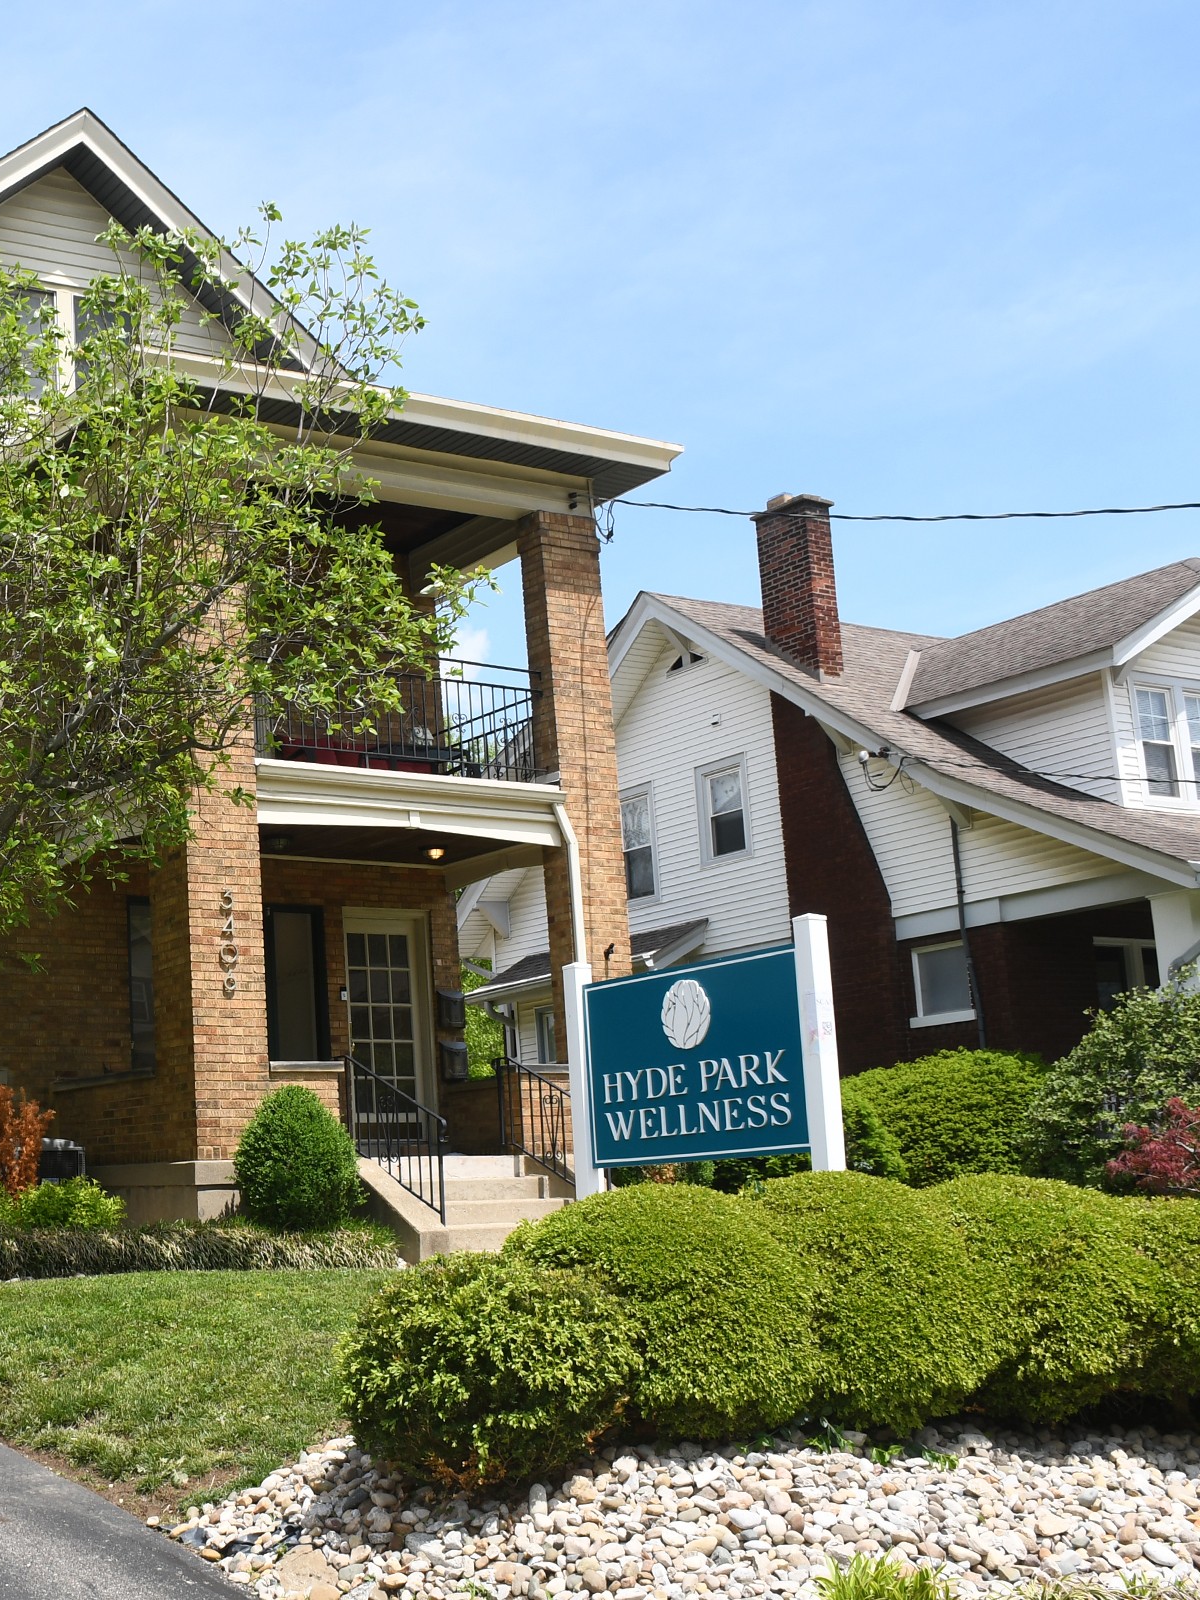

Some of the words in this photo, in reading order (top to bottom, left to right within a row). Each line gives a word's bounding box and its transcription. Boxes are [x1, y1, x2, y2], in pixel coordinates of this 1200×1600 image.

[220, 887, 238, 991] 3406
[603, 1063, 688, 1104] HYDE
[699, 1049, 789, 1093] PARK
[604, 1092, 792, 1141] WELLNESS
